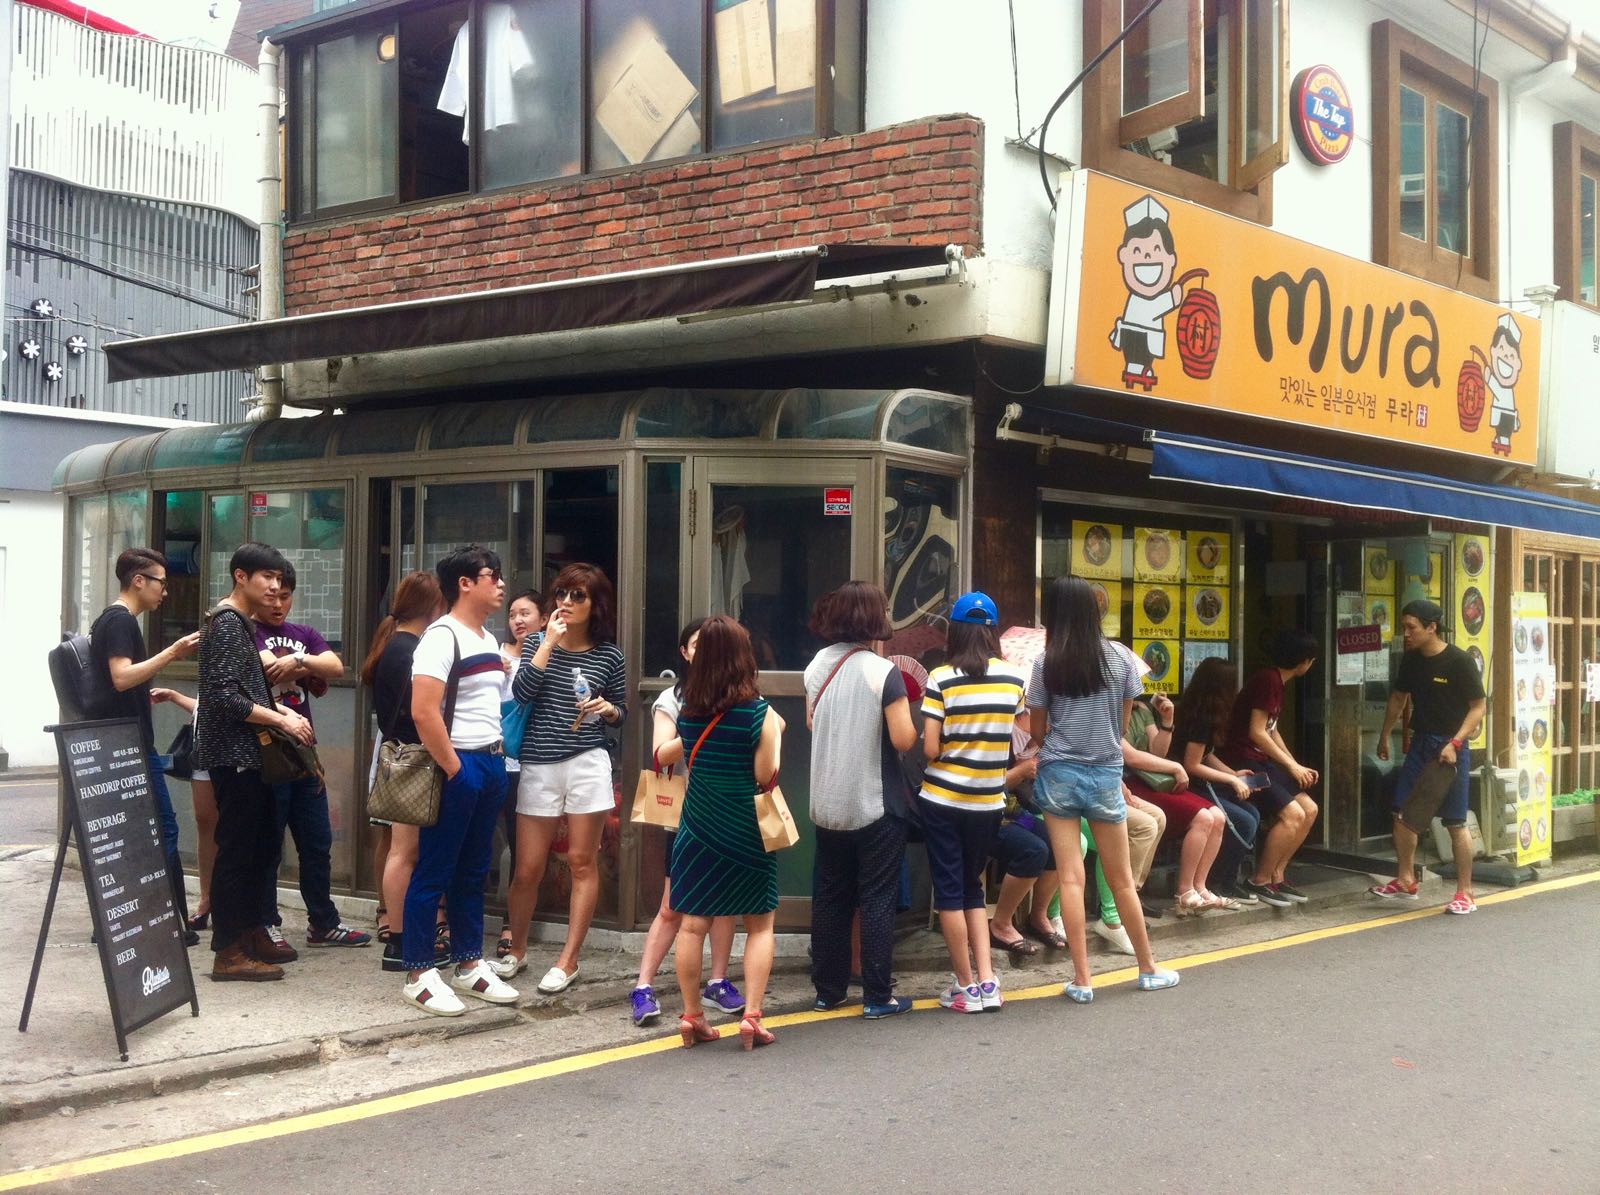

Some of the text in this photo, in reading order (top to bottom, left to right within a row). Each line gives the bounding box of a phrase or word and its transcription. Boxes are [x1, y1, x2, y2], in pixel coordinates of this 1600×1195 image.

[1313, 96, 1330, 119] The
[1280, 376, 1317, 408] 맛있는
[1320, 384, 1377, 420] 일본음식점
[1386, 397, 1414, 427] 무라
[1339, 631, 1379, 646] CLOSED
[70, 739, 102, 755] COFFEE
[80, 773, 147, 799] HANDDRIP COFFEE
[87, 811, 127, 833] BEVERAGE
[98, 873, 116, 888] TEA
[106, 898, 139, 921] DESSERT
[116, 947, 137, 966] BEER
